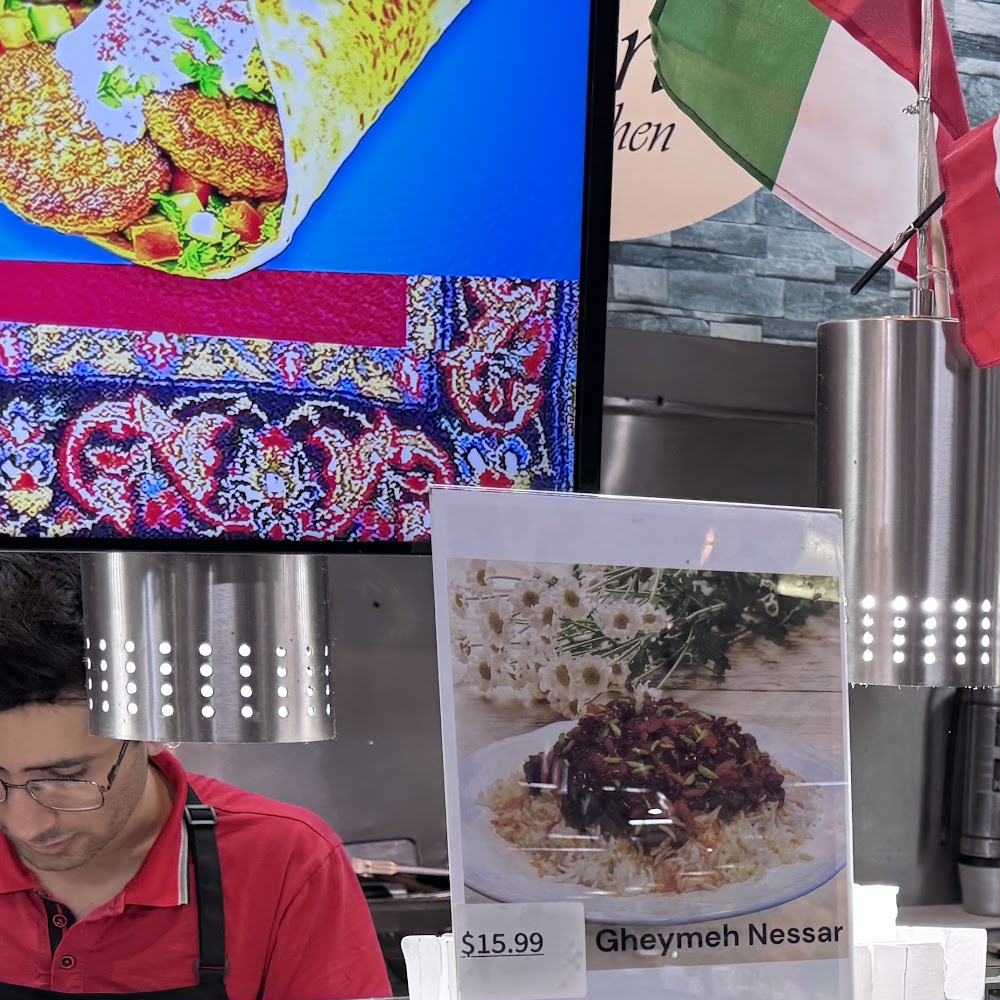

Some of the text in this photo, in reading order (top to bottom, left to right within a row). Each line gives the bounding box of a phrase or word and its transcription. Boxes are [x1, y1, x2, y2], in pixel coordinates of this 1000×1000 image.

[461, 930, 544, 957] $15.99
[595, 922, 844, 956] Gheymeh Nessar
